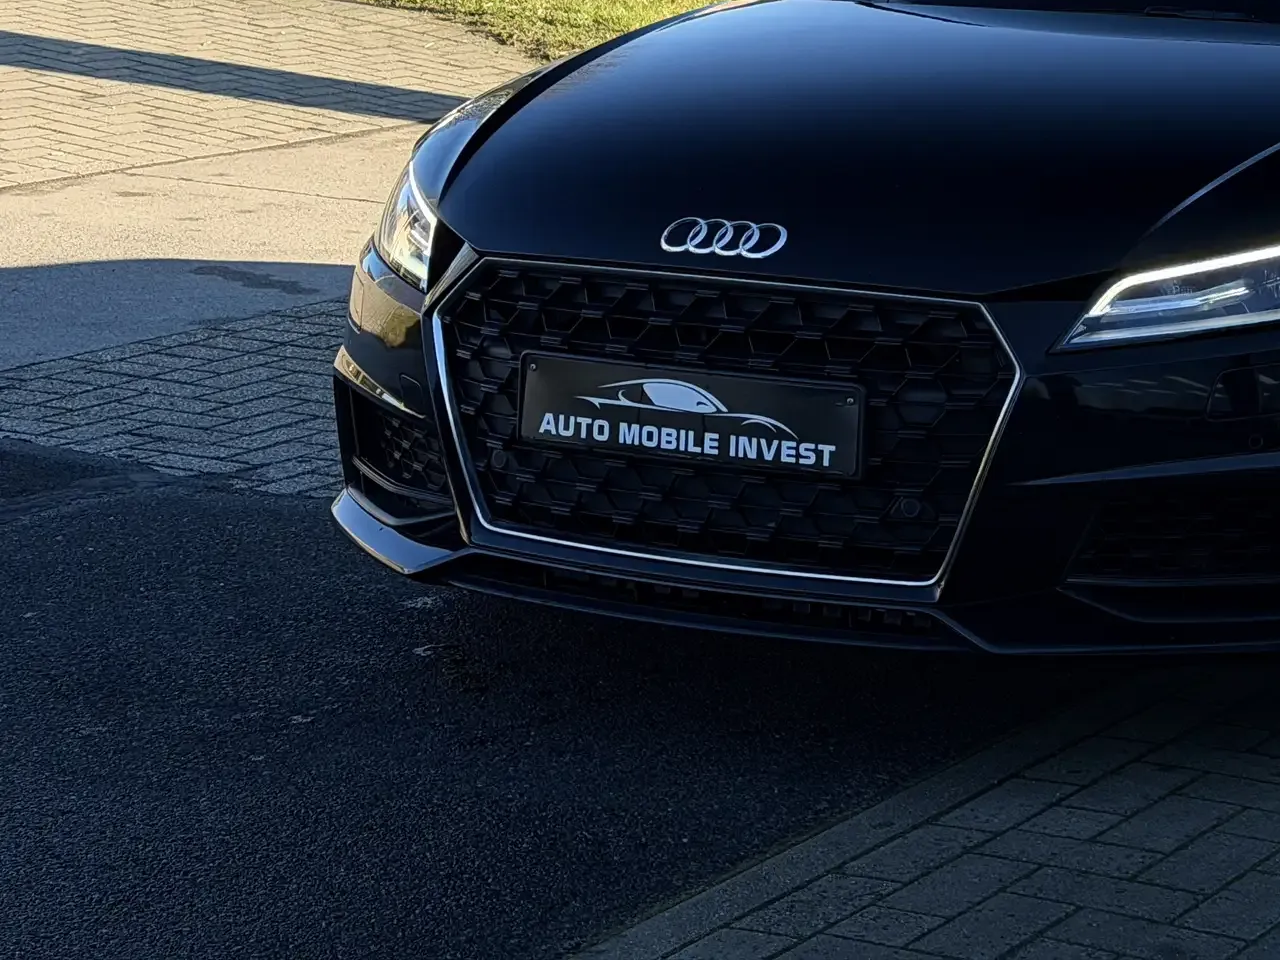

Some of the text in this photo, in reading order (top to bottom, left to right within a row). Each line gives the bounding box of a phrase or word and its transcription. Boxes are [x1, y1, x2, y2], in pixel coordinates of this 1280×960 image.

[538, 412, 836, 467] AUTO MOBILE INVEST
